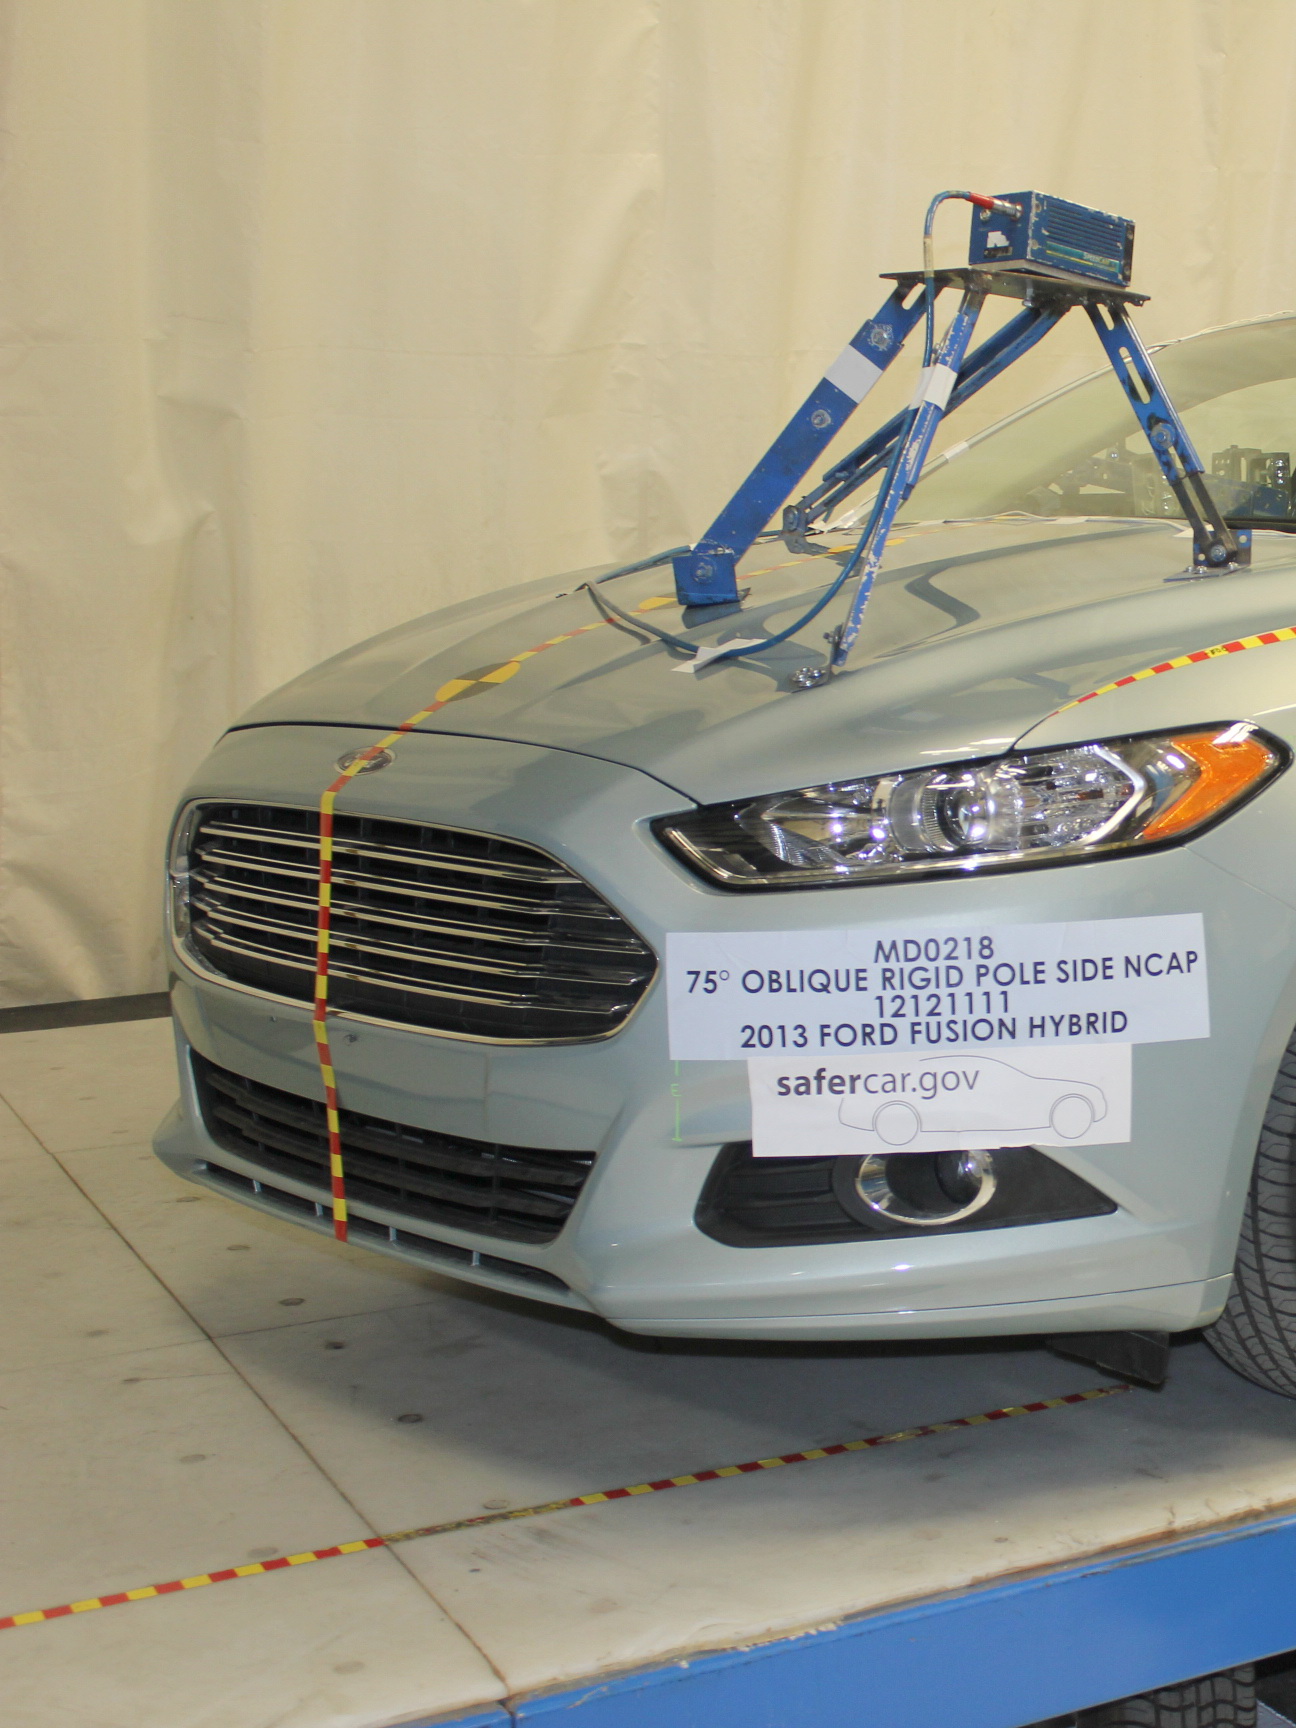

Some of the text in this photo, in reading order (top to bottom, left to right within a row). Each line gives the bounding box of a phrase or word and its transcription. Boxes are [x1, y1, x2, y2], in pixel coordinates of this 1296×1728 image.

[873, 936, 994, 963] MD0218
[741, 968, 868, 994] OBLIQUE
[881, 965, 964, 991] RIGID
[976, 961, 1047, 987] POLE
[1056, 957, 1114, 983] SIDE
[1124, 950, 1198, 979] NCAP
[874, 990, 1009, 1018] 12121111
[740, 1010, 1128, 1048] 2013 FORD FUSION HYBRID
[776, 1067, 980, 1100] safercar.gov
